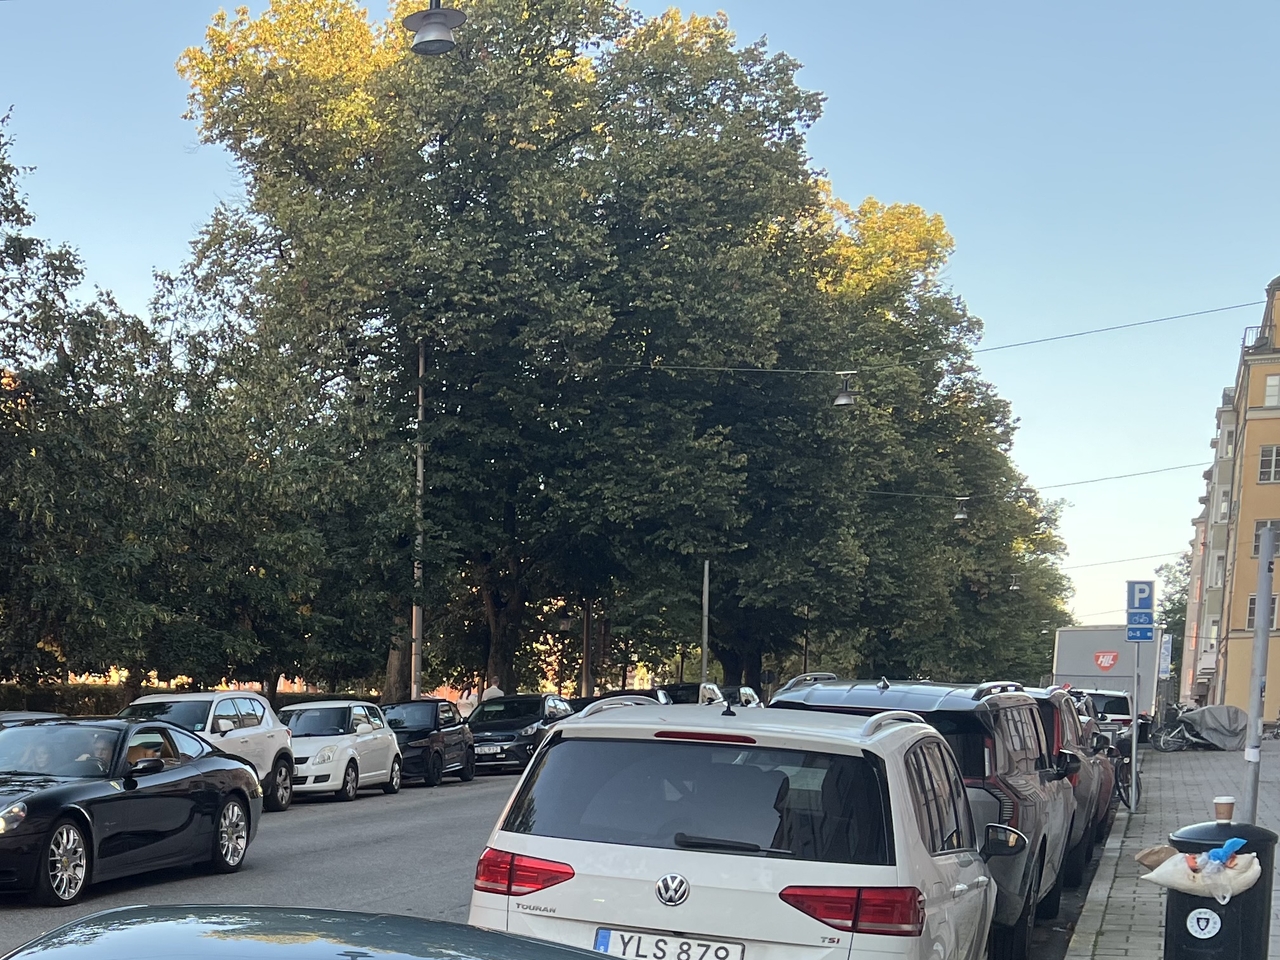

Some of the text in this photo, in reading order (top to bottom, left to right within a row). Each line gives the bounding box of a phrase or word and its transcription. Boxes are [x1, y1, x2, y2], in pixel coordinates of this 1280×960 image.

[1134, 583, 1150, 608] P
[516, 902, 556, 914] TOURAN
[620, 934, 668, 960] YLS
[820, 936, 840, 944] TSI
